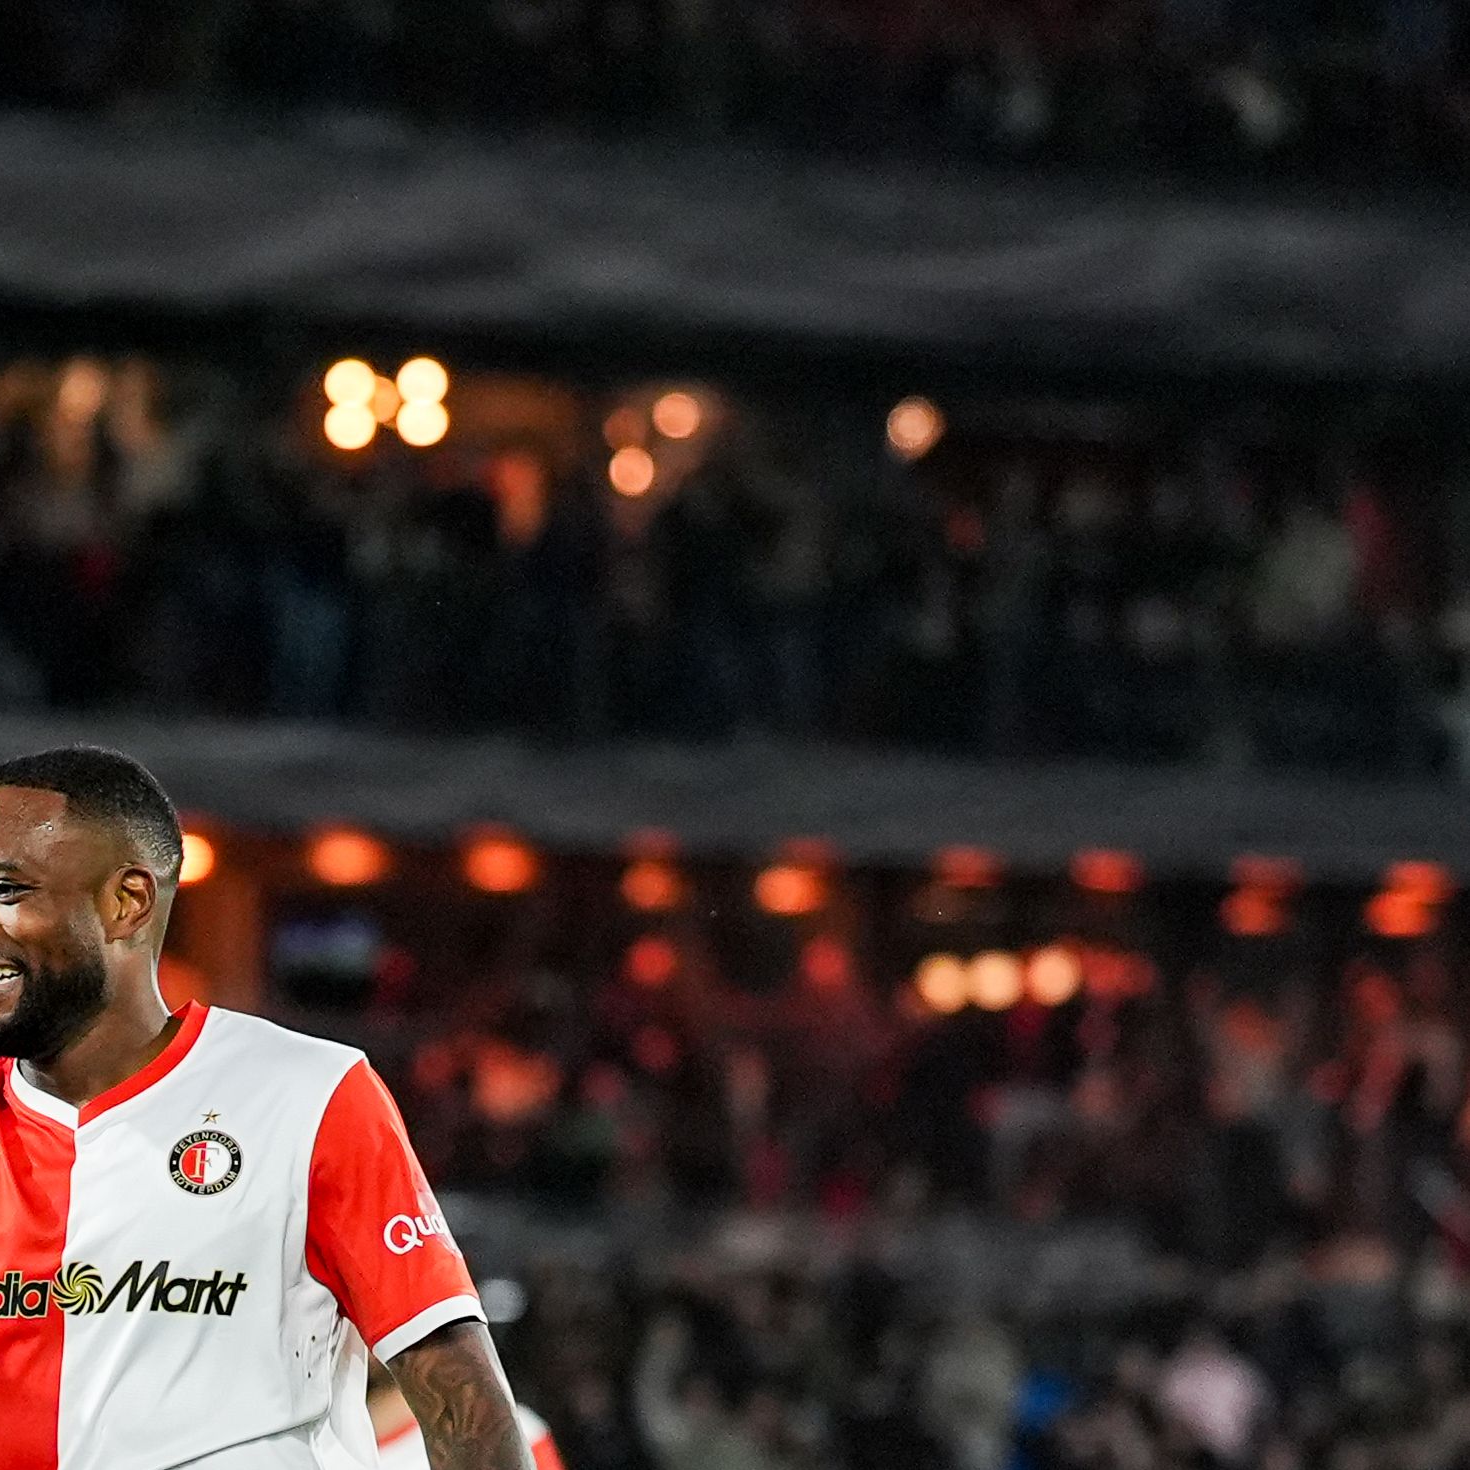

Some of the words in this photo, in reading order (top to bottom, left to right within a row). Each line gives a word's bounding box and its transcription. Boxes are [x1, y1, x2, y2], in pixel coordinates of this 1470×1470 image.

[174, 1131, 238, 1155] FEYENOORD
[171, 1170, 237, 1195] ROTTERDAM
[96, 1260, 248, 1316] Markt
